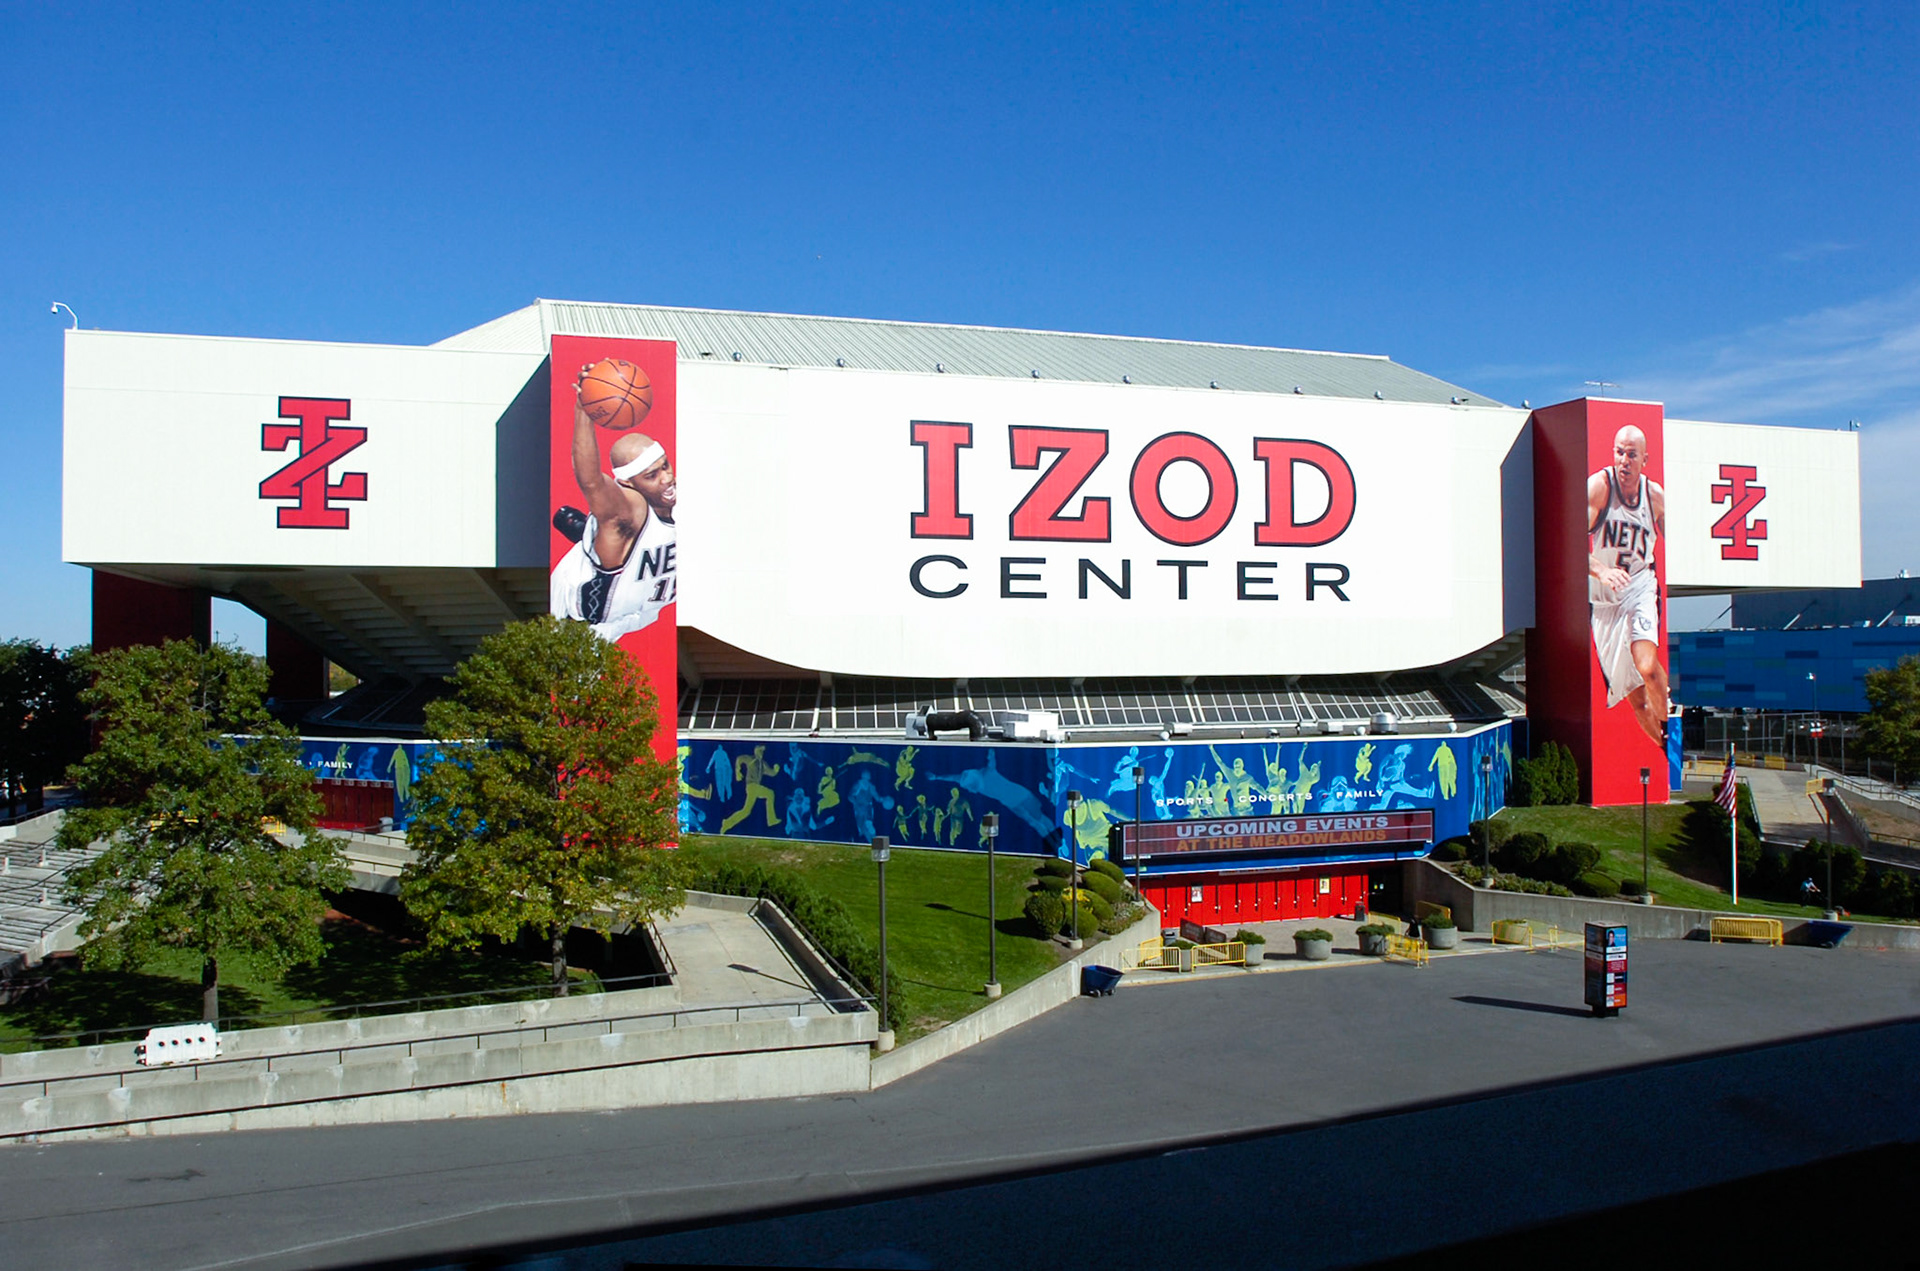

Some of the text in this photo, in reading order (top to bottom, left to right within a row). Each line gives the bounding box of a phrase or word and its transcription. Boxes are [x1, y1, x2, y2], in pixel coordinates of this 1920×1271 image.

[910, 420, 1357, 548] IZOD
[1602, 520, 1650, 561] NETS
[1615, 551, 1632, 574] 5
[909, 554, 1351, 601] CENTER
[317, 760, 353, 769] FAMILY
[1156, 789, 1384, 807] SPORTS CONCERTS FAMILY
[1176, 816, 1389, 837] UPCOMING EVENTS
[1176, 830, 1387, 851] AT THE MEADOWLANDS
